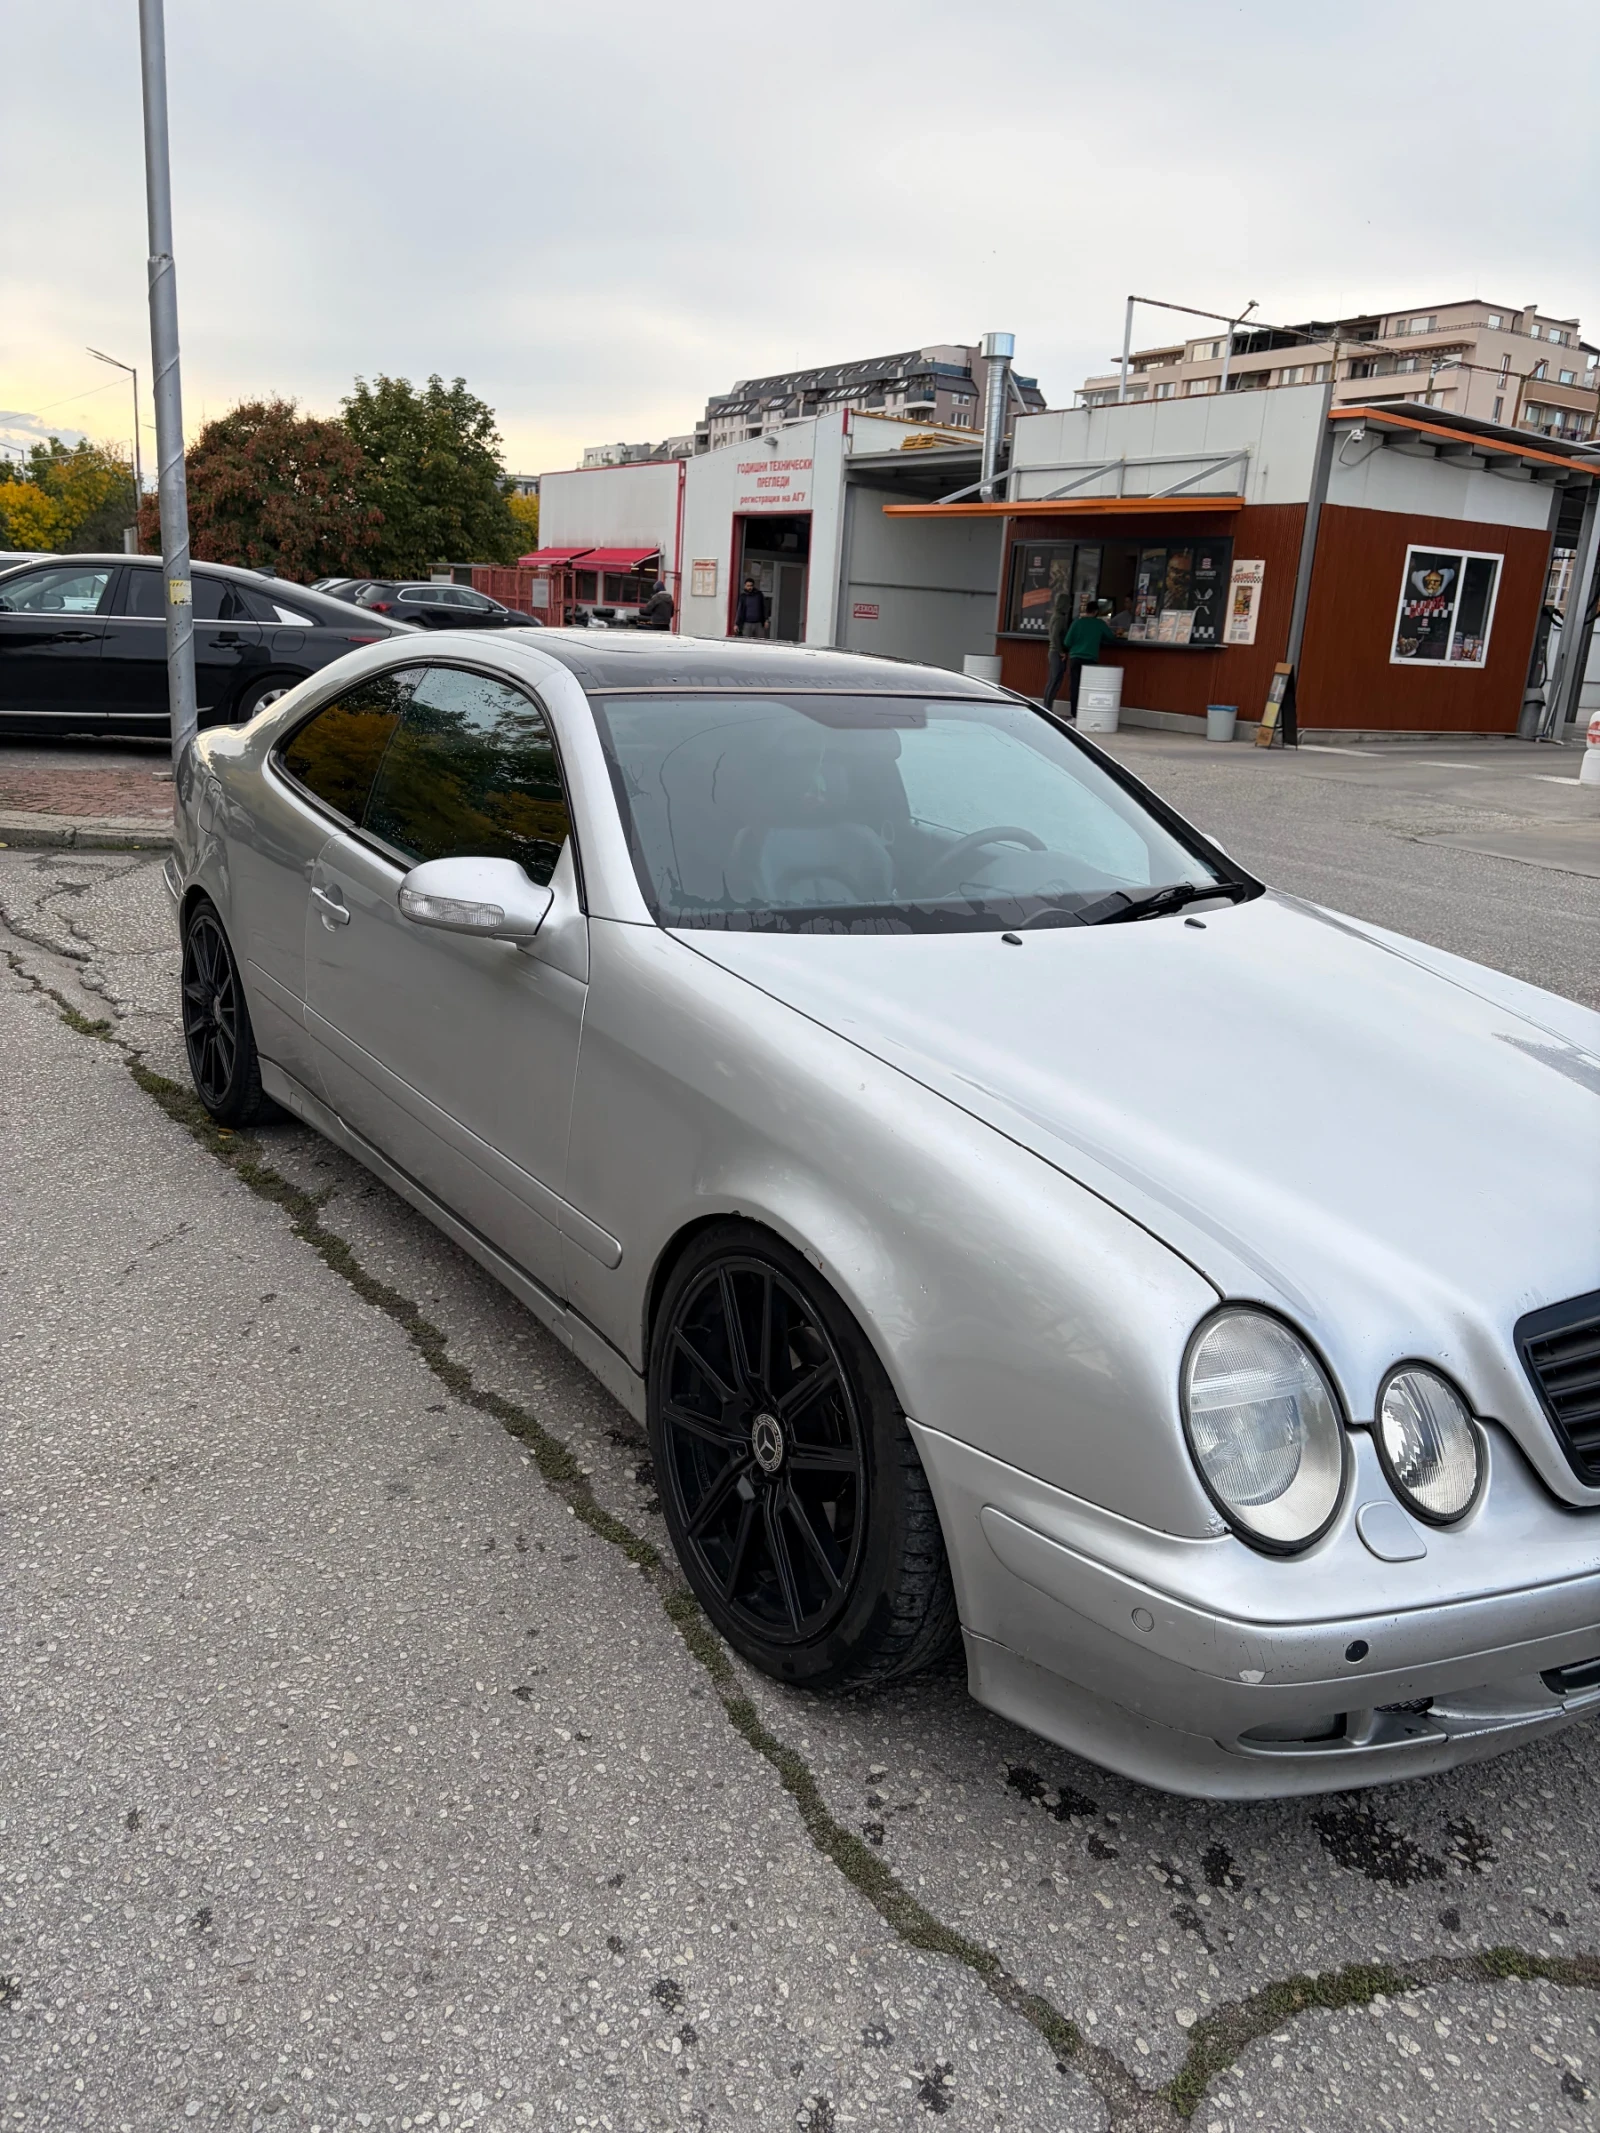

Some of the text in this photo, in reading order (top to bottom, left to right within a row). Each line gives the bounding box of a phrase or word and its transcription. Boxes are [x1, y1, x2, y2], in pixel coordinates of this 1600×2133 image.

[737, 459, 812, 474] ГОДИШНИ ТЕХНИЧЕСКИ
[757, 476, 790, 488] ПРЕГЛЕДИ
[740, 496, 780, 505] регистрация
[792, 492, 806, 502] АГУ
